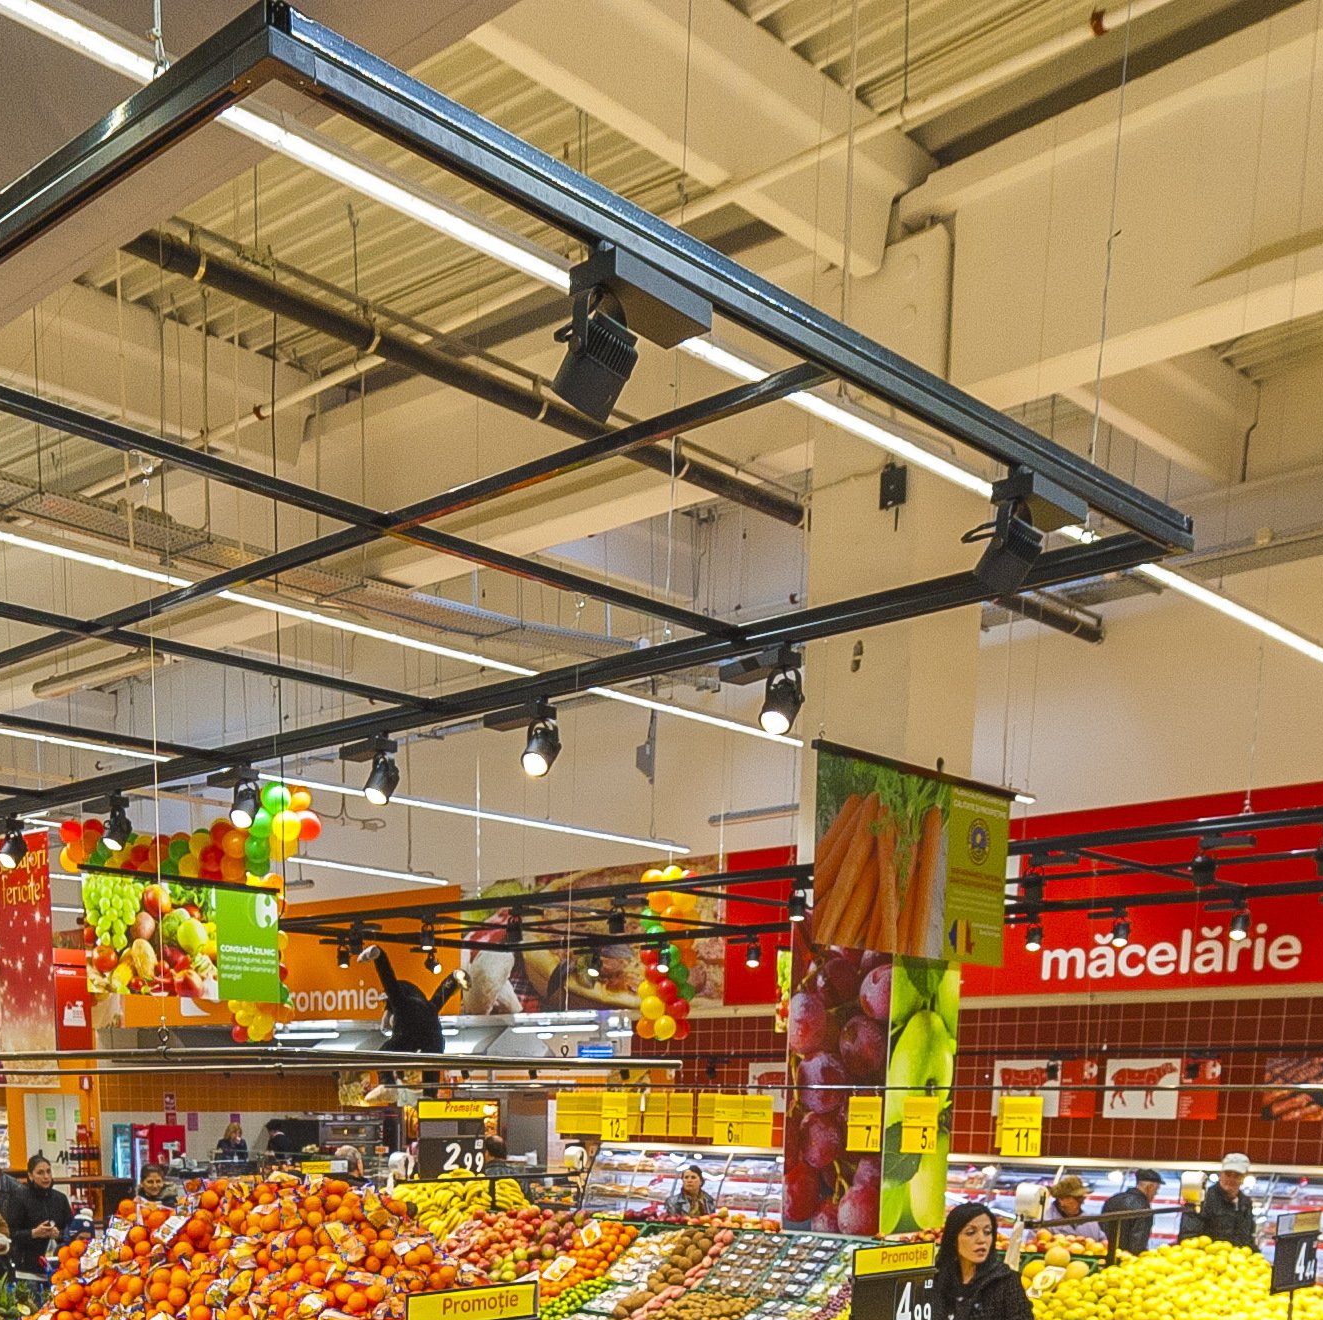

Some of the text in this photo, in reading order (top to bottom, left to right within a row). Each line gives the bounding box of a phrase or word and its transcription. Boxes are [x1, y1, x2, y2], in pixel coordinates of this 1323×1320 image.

[1041, 923, 1303, 982] măcelărie
[289, 980, 378, 1012] ronomie
[609, 1118, 620, 1139] 12
[727, 1121, 734, 1143] 6
[865, 1126, 872, 1148] 7
[920, 1127, 927, 1150] 5
[1015, 1128, 1029, 1153] 11
[443, 1142, 484, 1172] 2 99
[881, 1246, 928, 1265] Promoție
[1295, 1242, 1307, 1281] 4
[443, 1290, 519, 1315] Promoție
